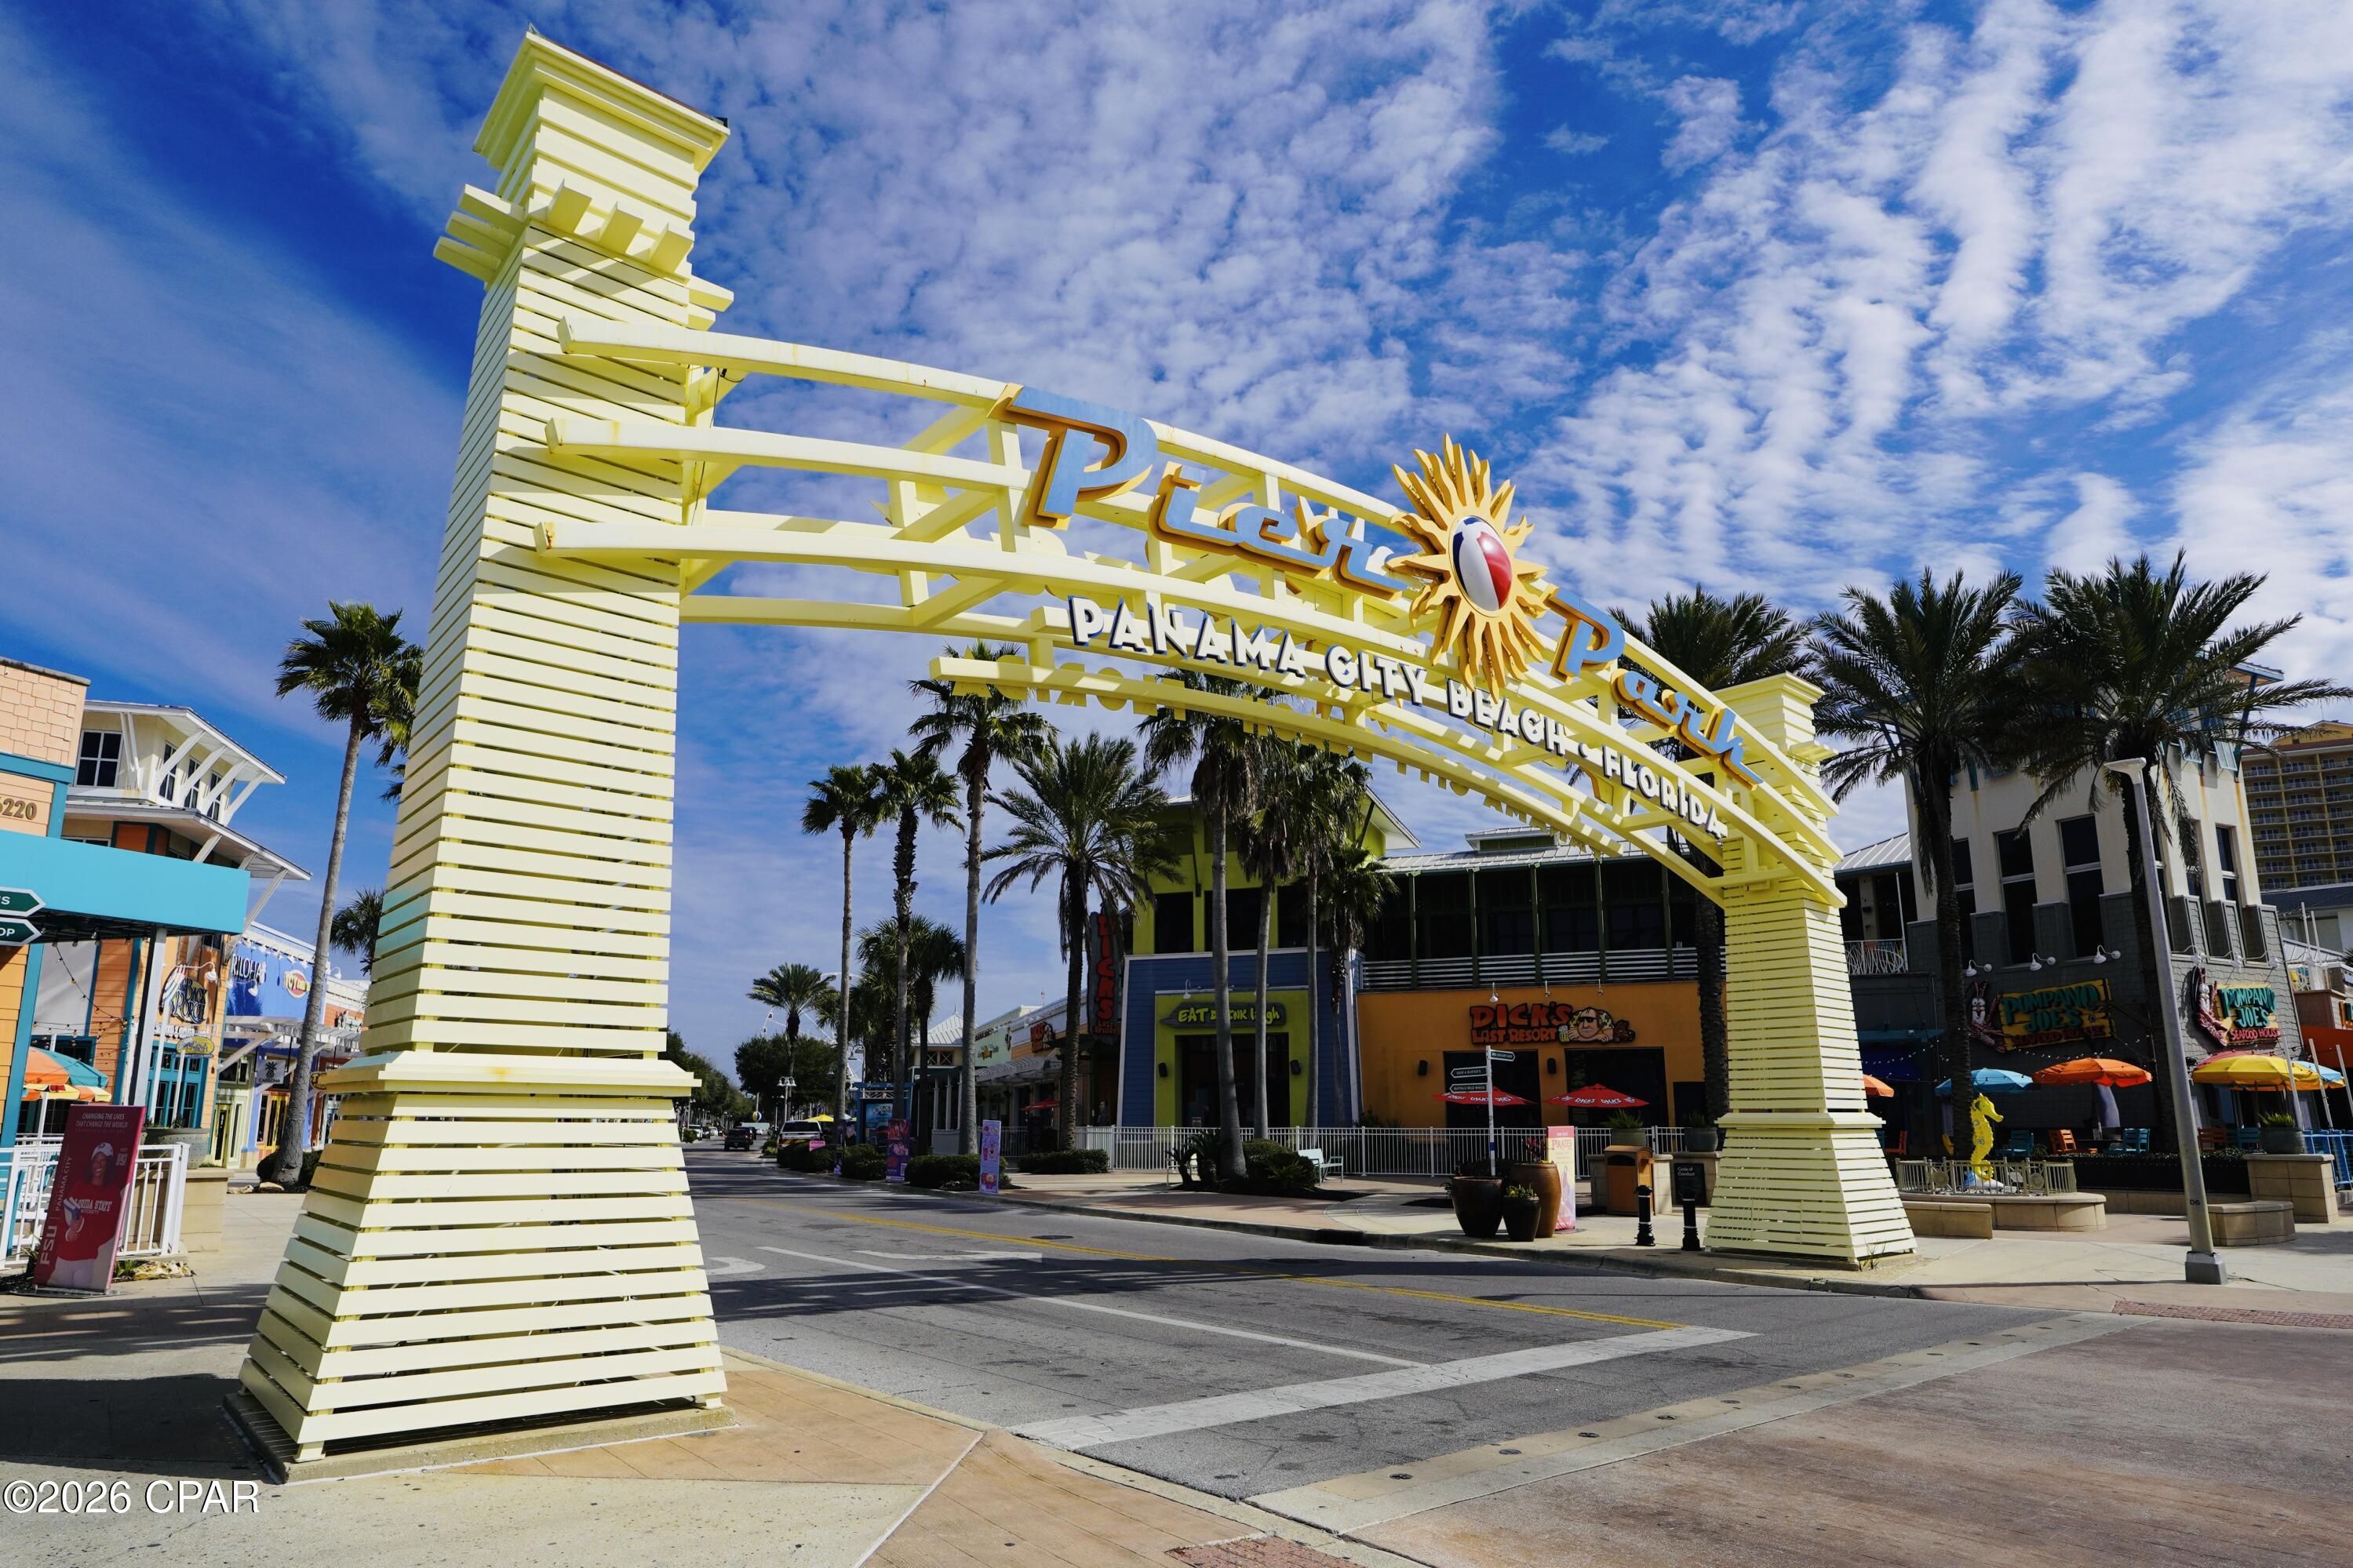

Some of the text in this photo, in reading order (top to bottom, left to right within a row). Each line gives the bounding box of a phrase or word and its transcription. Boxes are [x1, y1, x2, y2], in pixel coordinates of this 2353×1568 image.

[1006, 385, 1411, 602] Pier
[1547, 587, 1764, 791] Park
[1068, 595, 1307, 679] PANAMA
[1325, 644, 1428, 707] CITY
[1446, 677, 1568, 757] BEACH
[1601, 744, 1728, 840] FLORIDA
[1178, 1006, 1209, 1024] EAT
[1470, 1002, 1572, 1029] DICK'S
[2002, 984, 2101, 1025] POMPANO
[2220, 987, 2278, 1018] POMPANO
[2235, 1005, 2271, 1028] JOE'S
[1471, 1028, 1558, 1043] LAST RESORT
[2231, 1028, 2258, 1041] SEAFOOD
[40, 1224, 58, 1266] FSU
[55, 1176, 67, 1212] PANAMA
[62, 1155, 73, 1176] CITY
[93, 1199, 113, 1213] STATE
